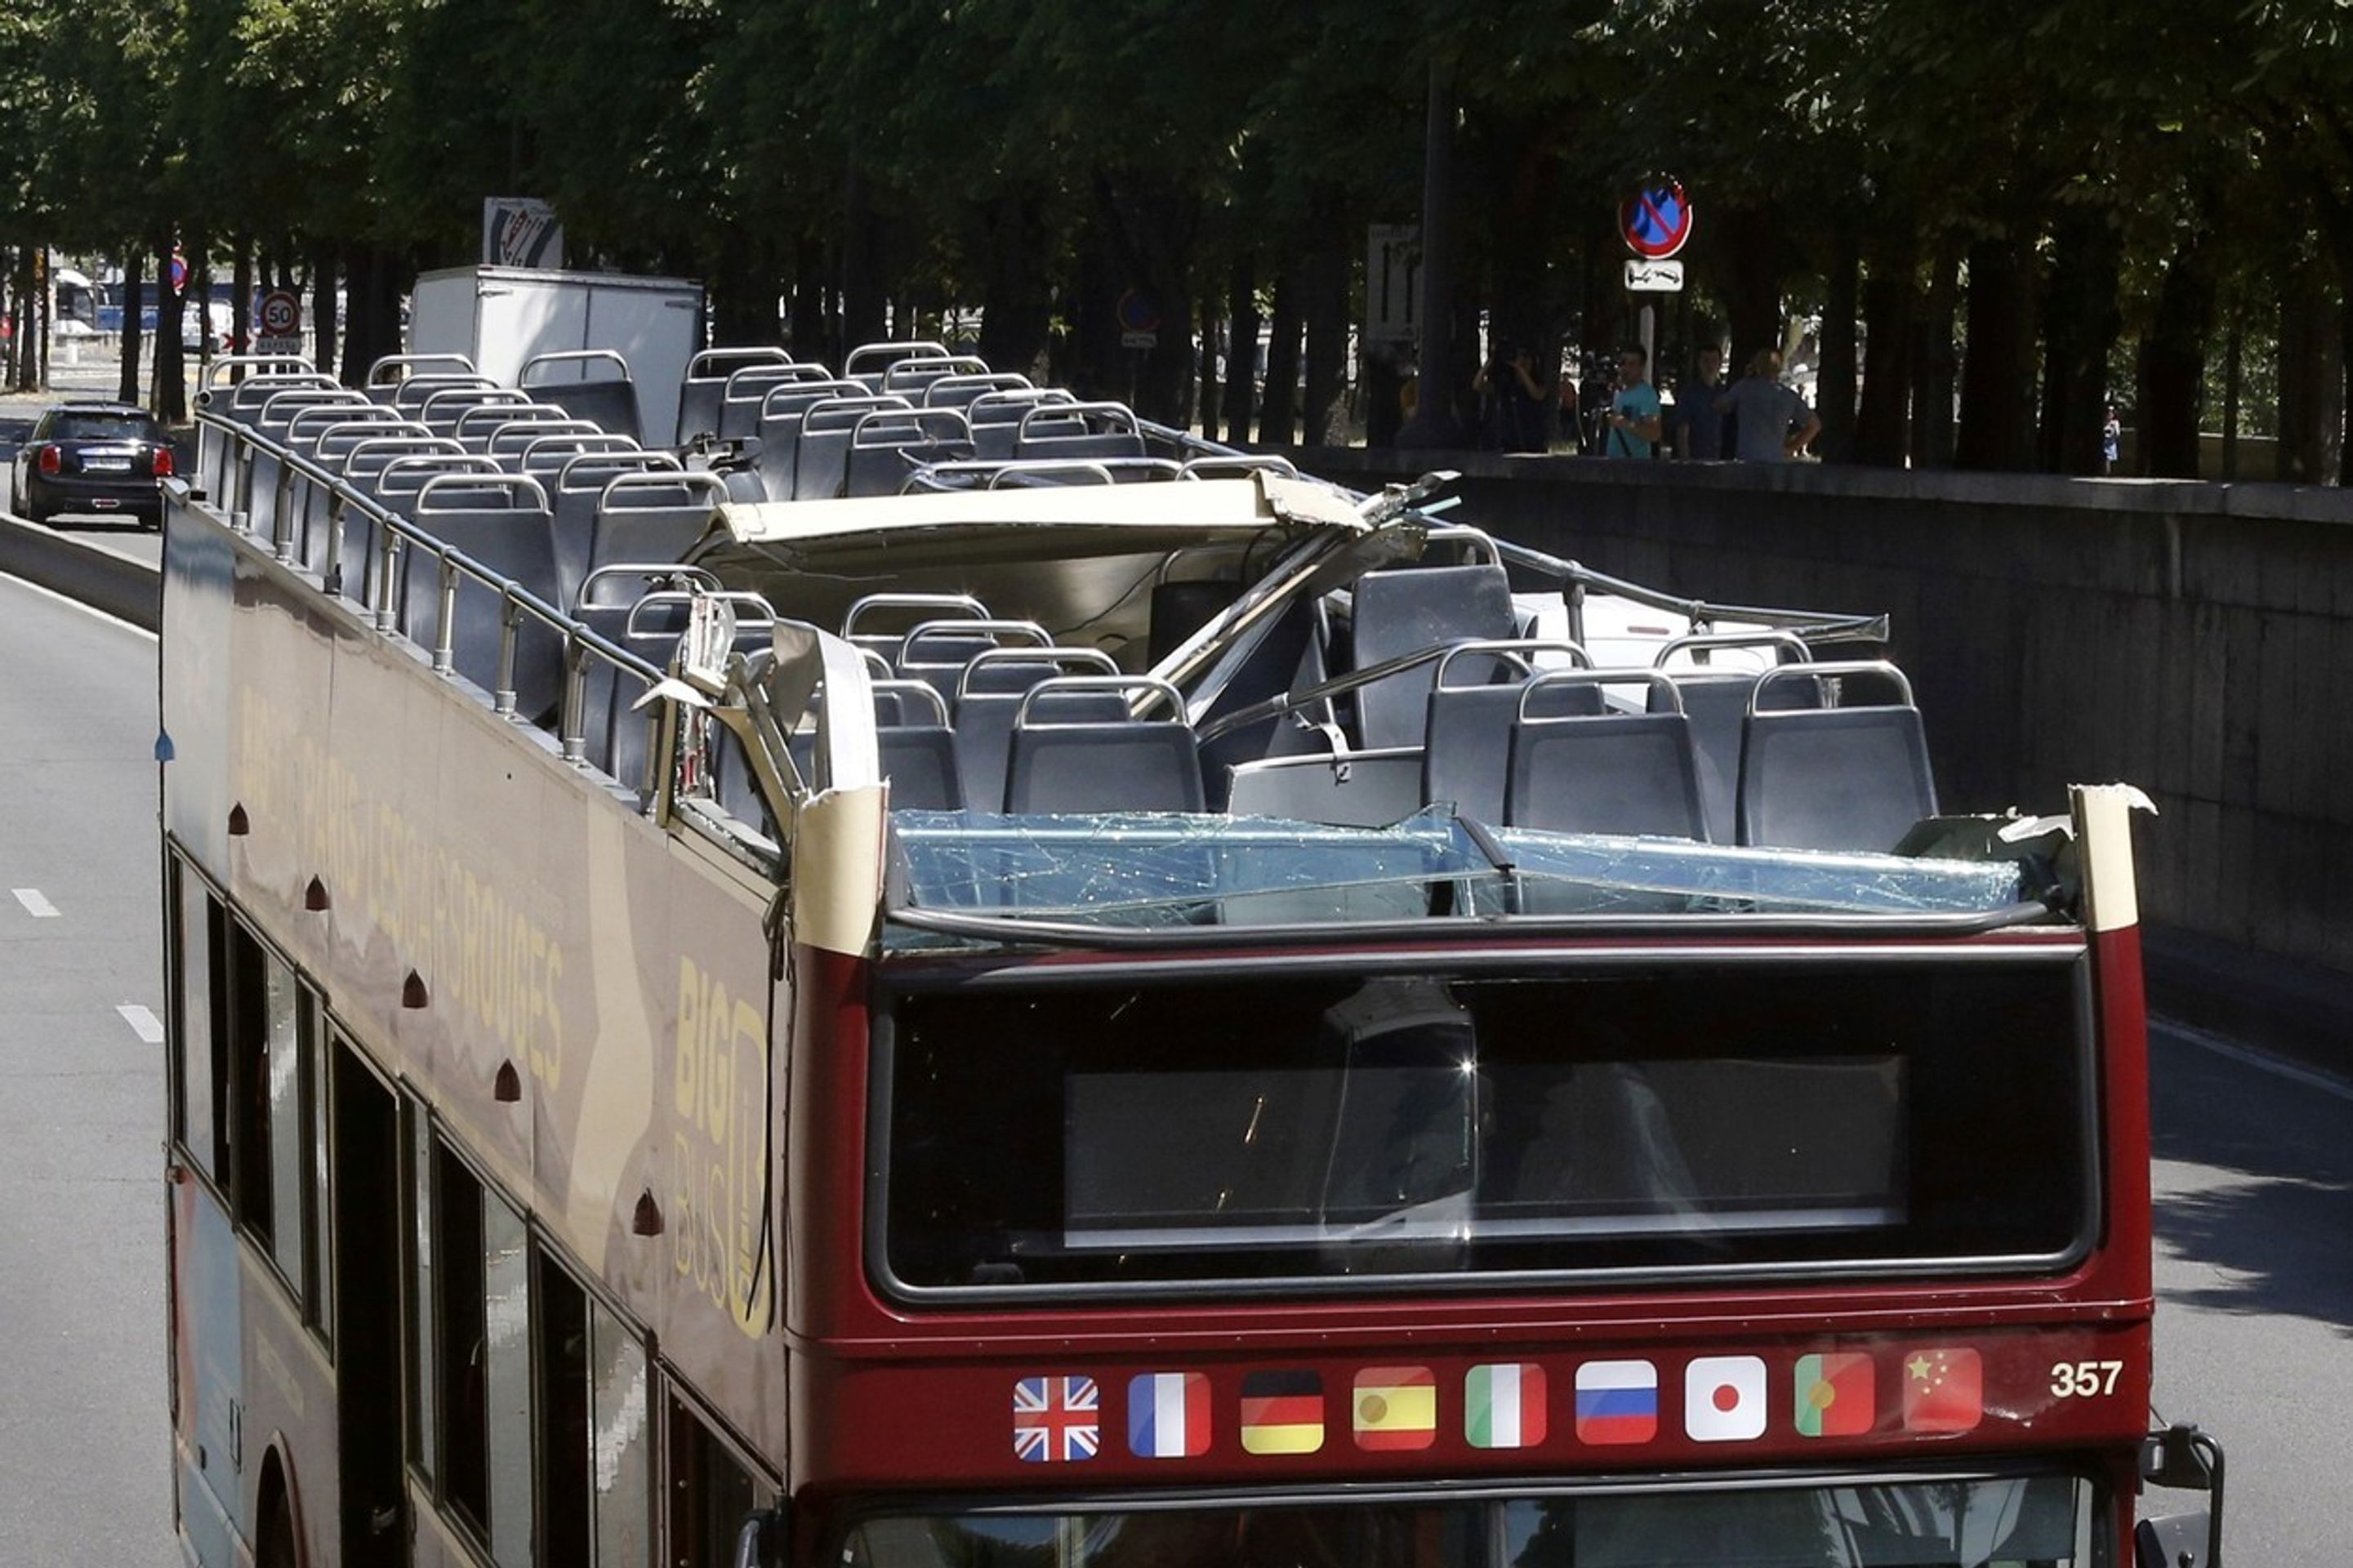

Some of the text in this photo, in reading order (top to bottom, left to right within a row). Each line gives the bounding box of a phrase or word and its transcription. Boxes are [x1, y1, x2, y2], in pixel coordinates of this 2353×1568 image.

[269, 306, 292, 323] 50
[464, 868, 564, 1093] ROUGES
[675, 955, 729, 1144] BIG
[675, 1131, 726, 1309] BUS
[2050, 1361, 2123, 1398] 357
